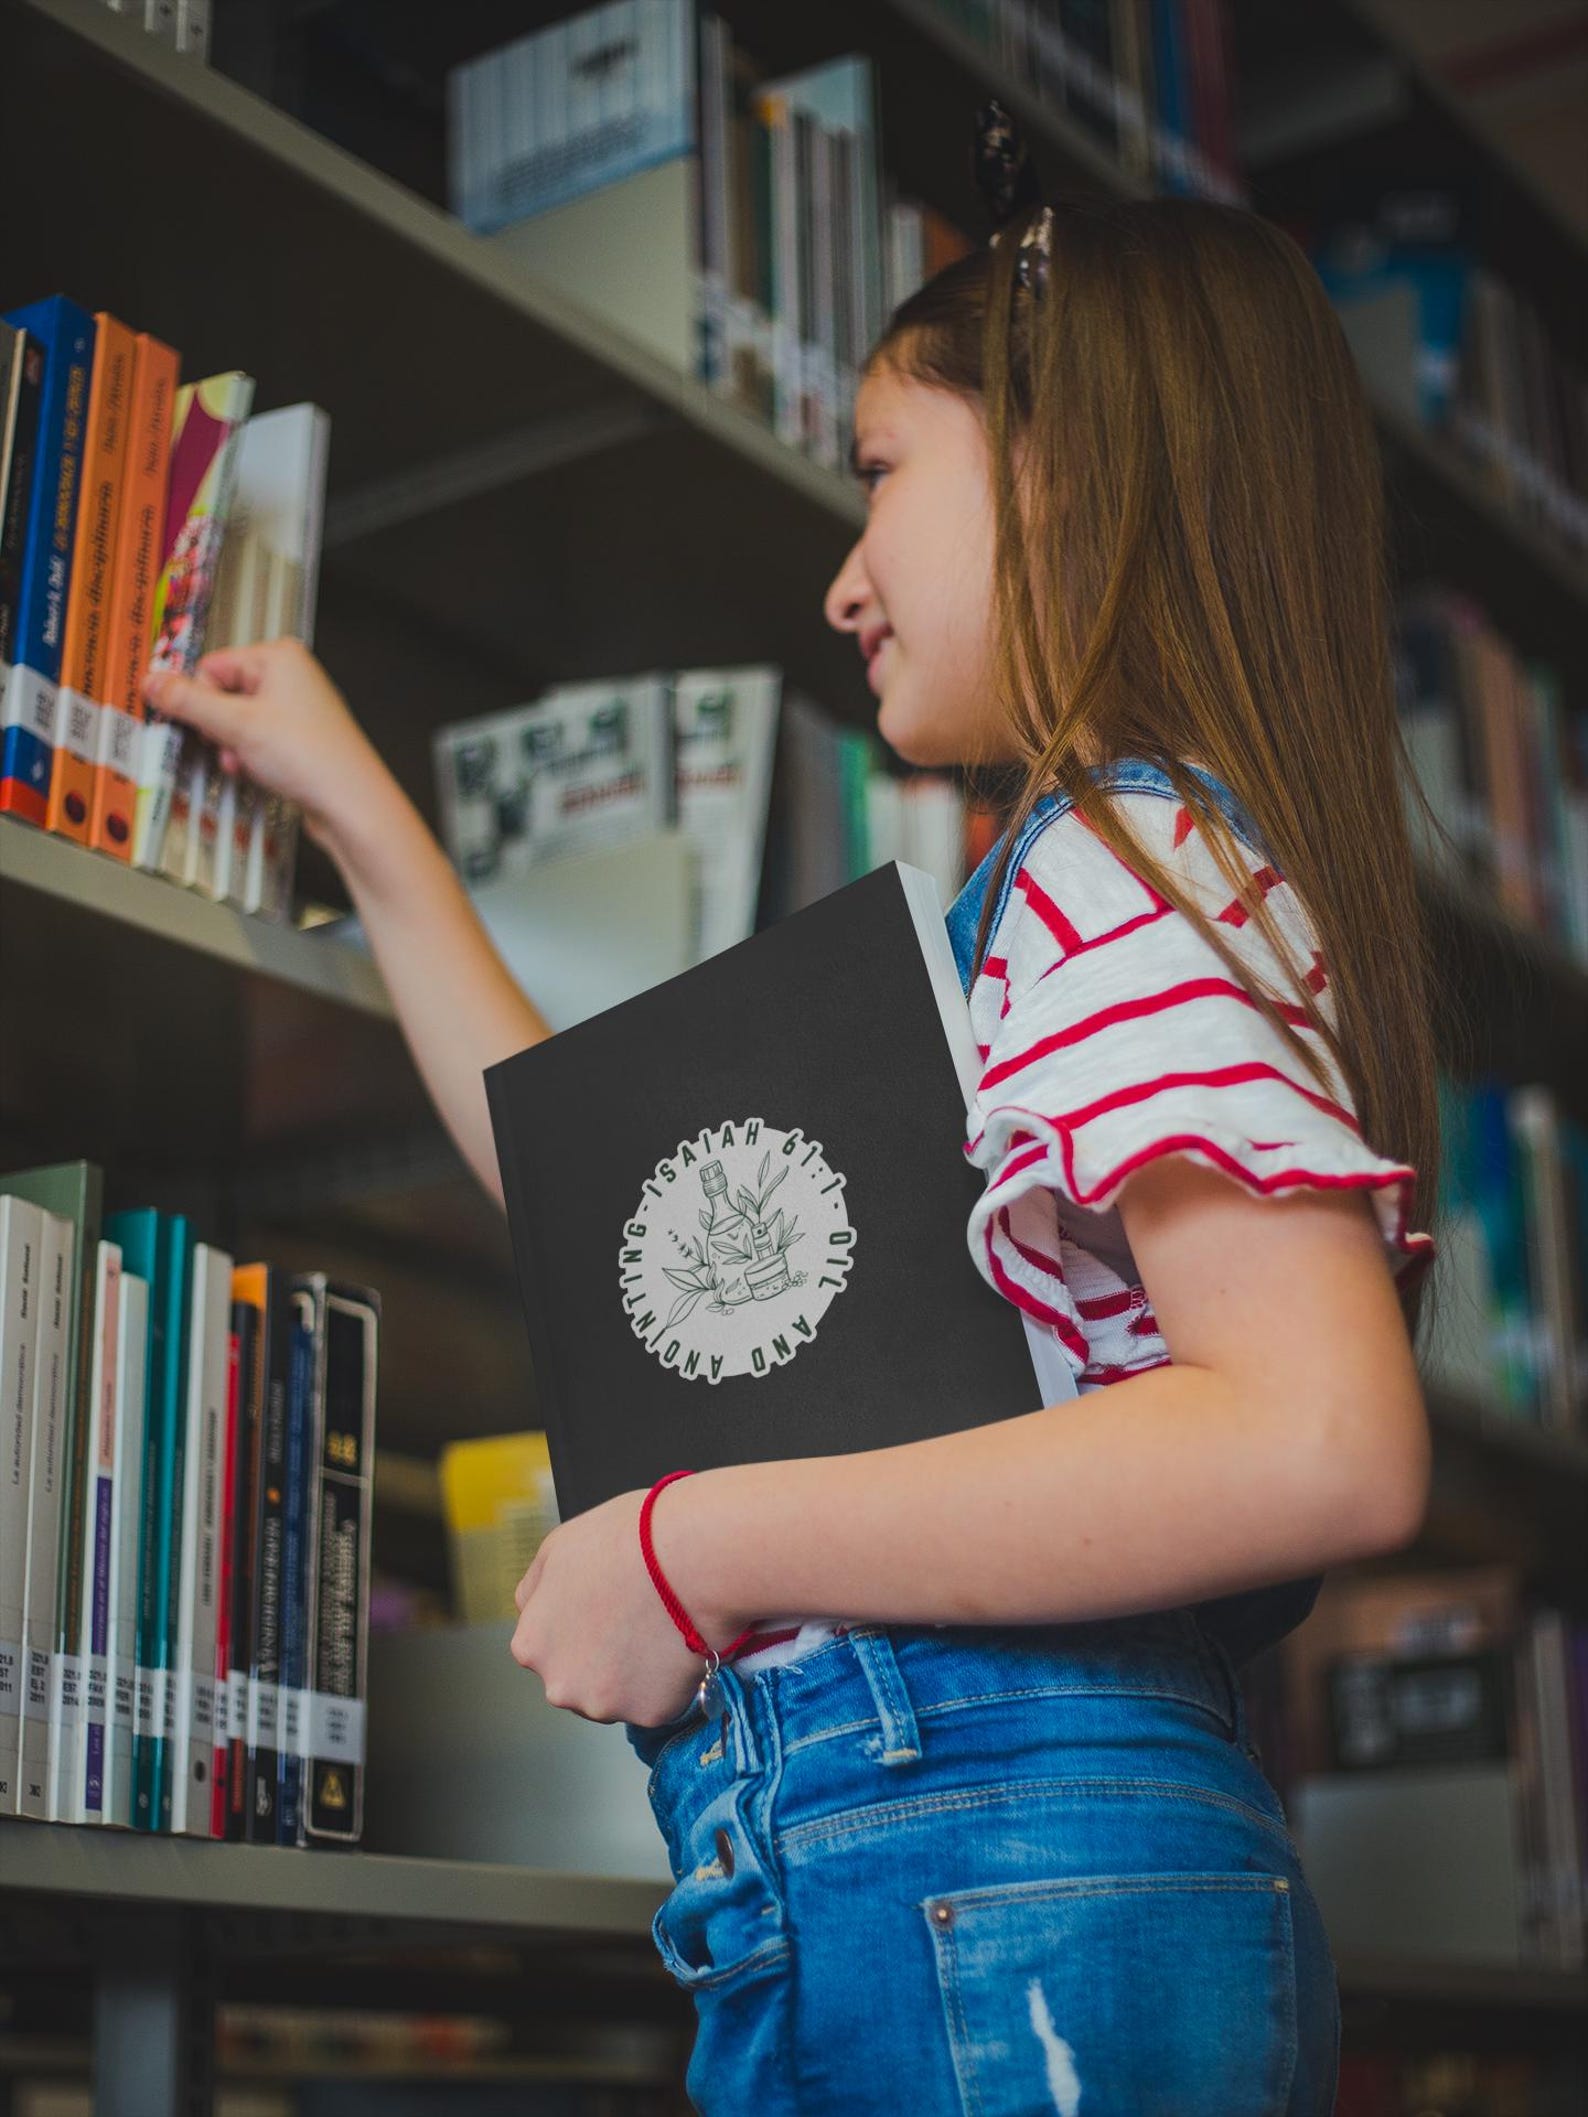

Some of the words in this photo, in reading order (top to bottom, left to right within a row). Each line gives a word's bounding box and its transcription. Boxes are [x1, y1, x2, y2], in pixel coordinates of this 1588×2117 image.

[646, 1121, 760, 1198] ISAIAH
[817, 1230, 852, 1288] OIL
[622, 1221, 724, 1380] ANOINTING
[750, 1314, 813, 1372] AND
